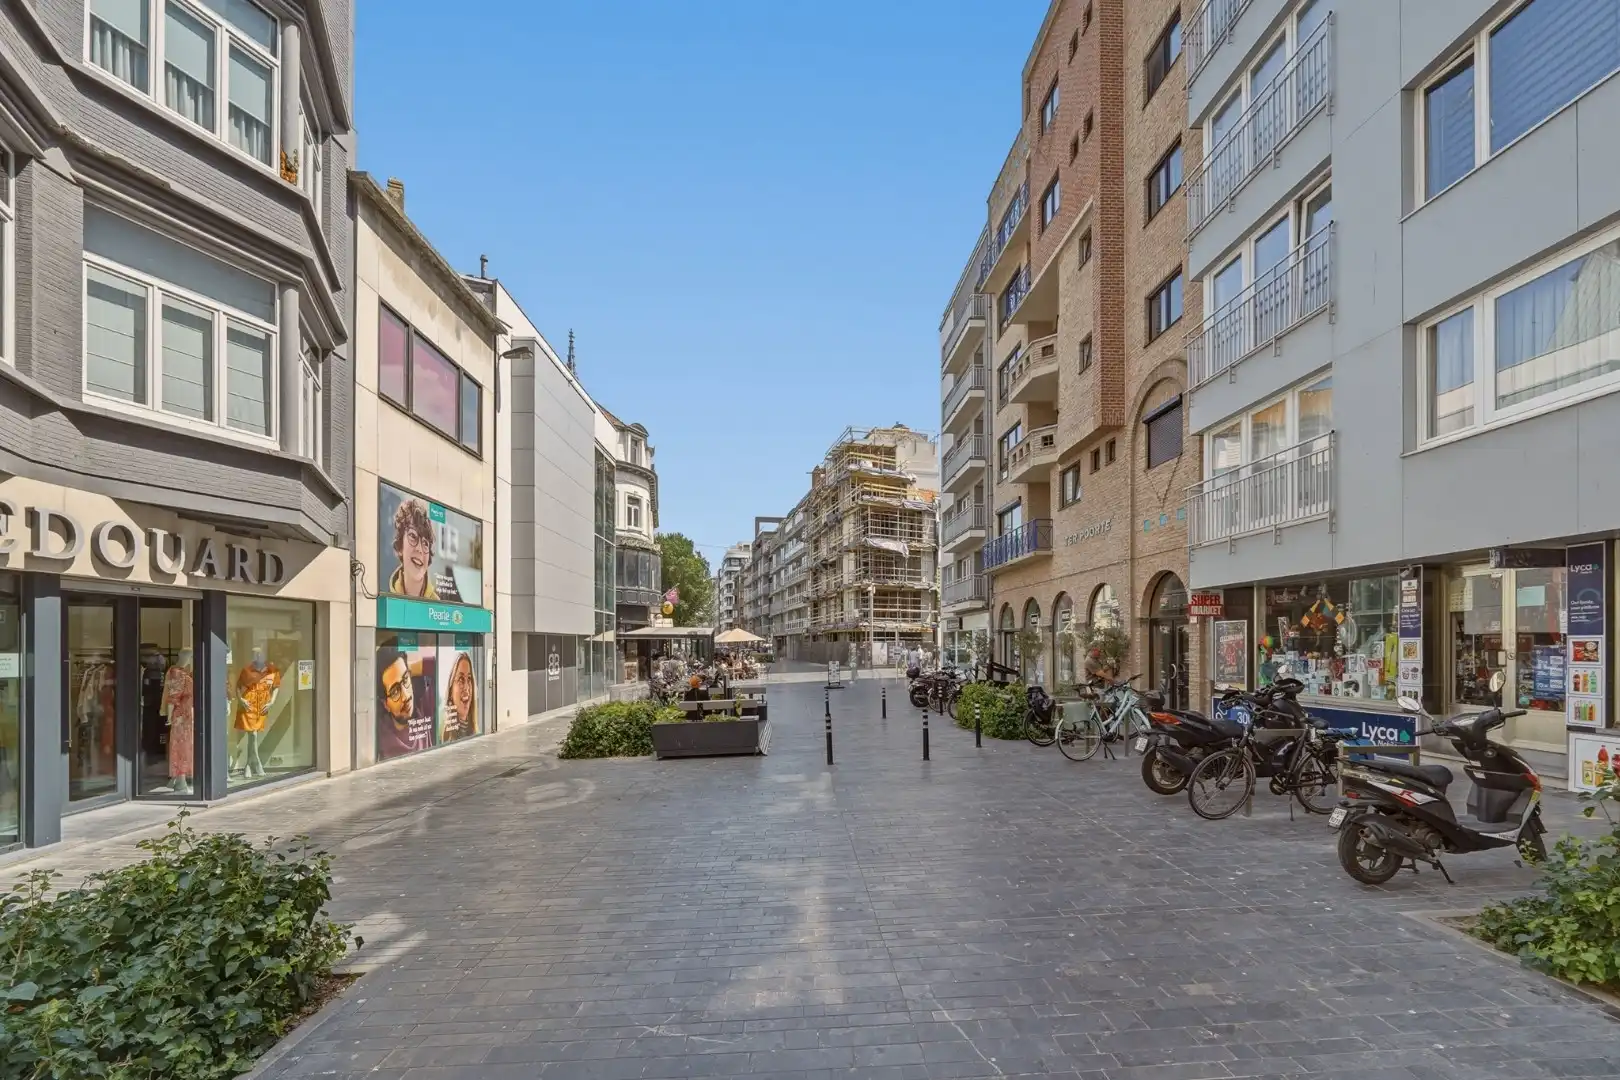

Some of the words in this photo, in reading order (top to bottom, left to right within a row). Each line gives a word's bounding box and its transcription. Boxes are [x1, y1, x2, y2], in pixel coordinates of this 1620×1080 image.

[1570, 564, 1593, 572] Lyca
[1191, 594, 1221, 606] SUPER
[428, 607, 450, 621] Pearle
[1191, 605, 1222, 615] MARKET
[1361, 721, 1399, 742] Lyca
